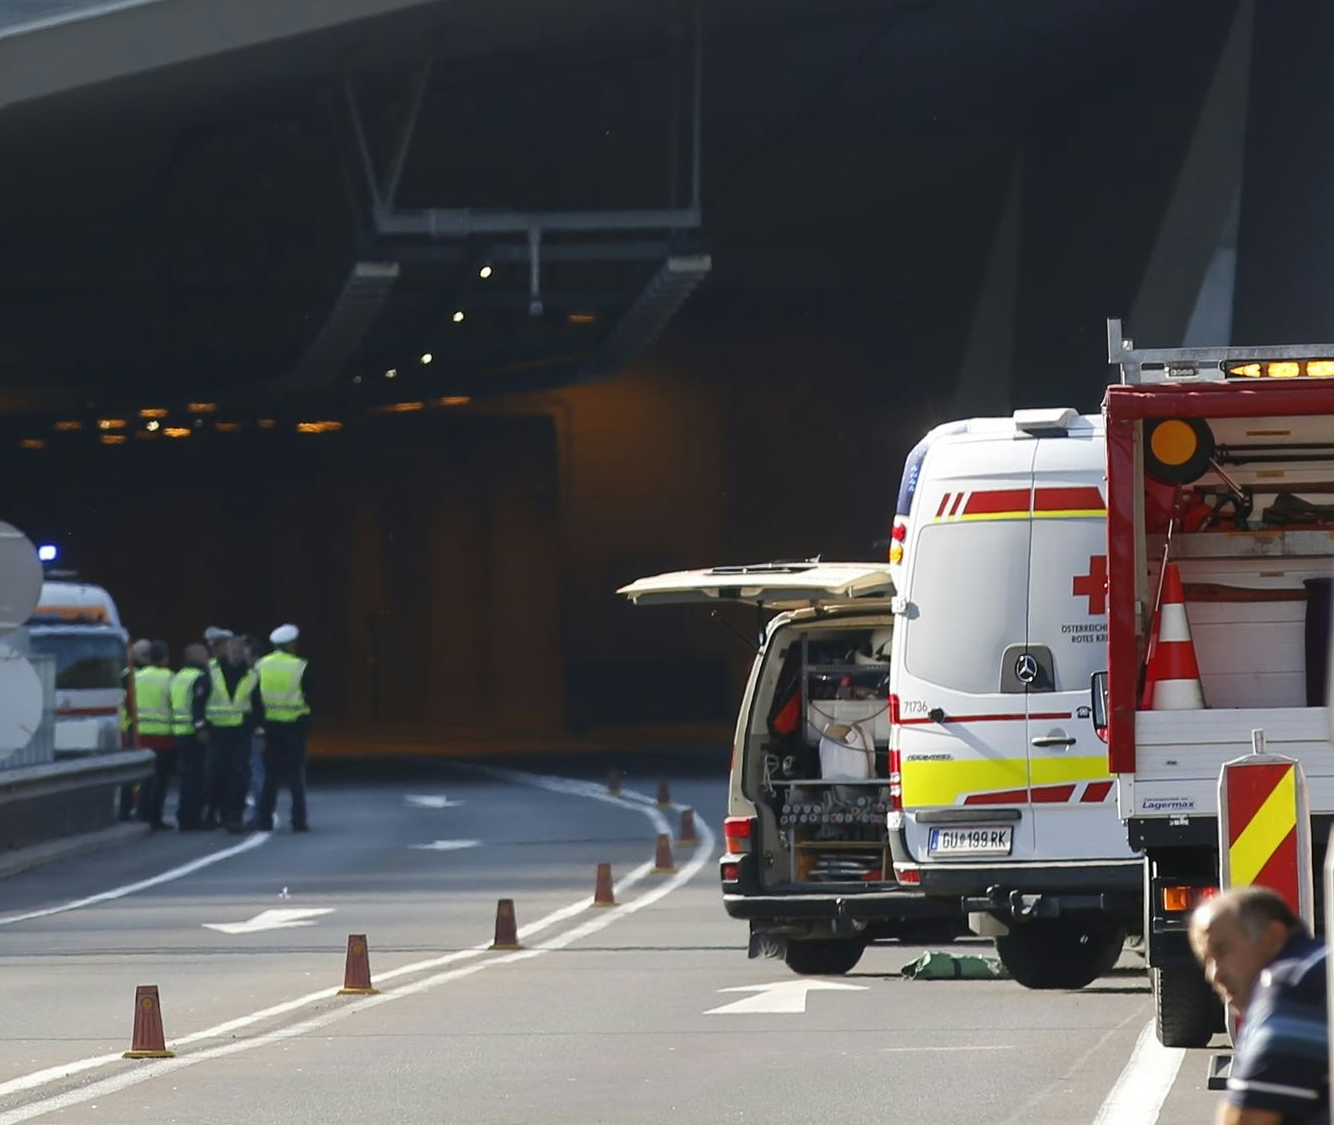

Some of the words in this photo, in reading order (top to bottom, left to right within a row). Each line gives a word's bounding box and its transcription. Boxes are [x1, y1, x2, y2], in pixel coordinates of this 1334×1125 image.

[904, 700, 928, 713] 71736
[1142, 800, 1195, 810] Lagermax
[942, 832, 958, 849] GU
[968, 832, 988, 848] 199
[990, 831, 1007, 847] RK
